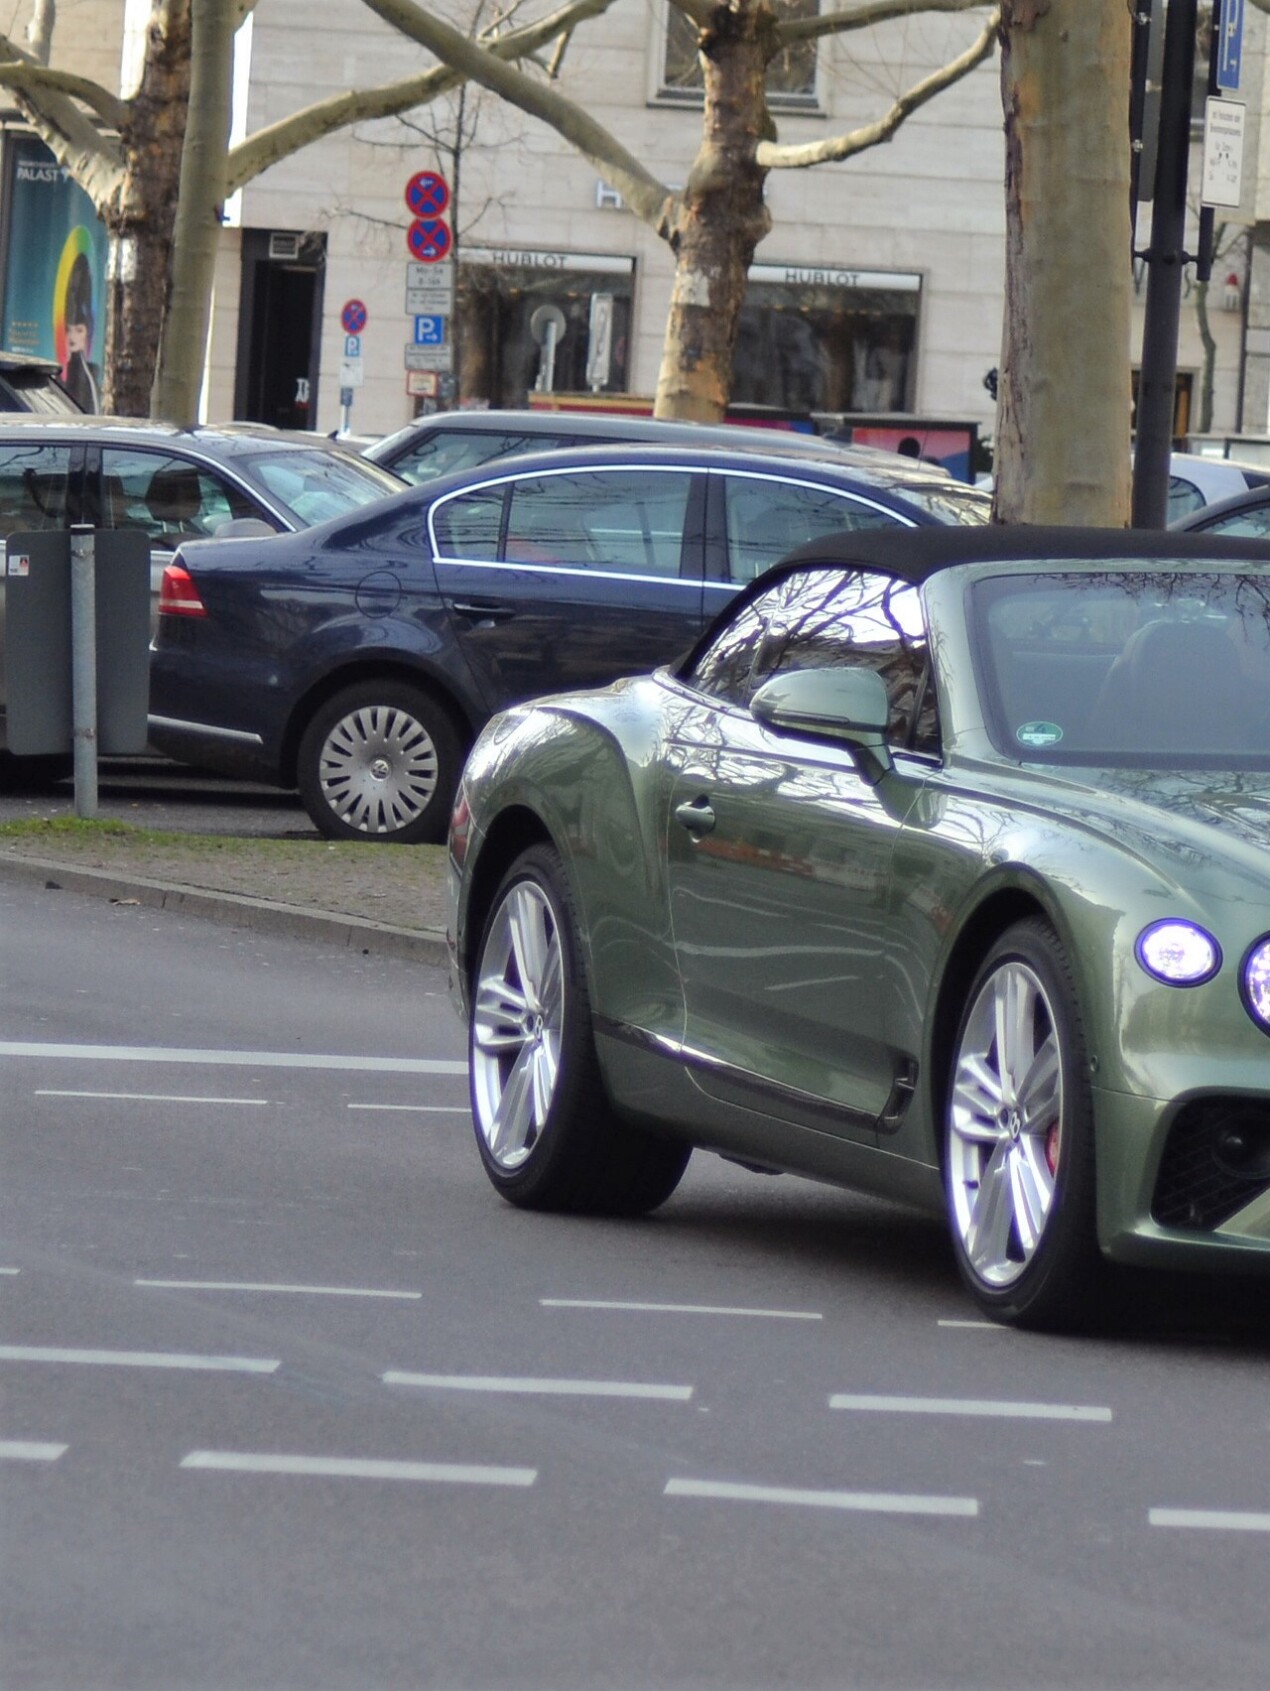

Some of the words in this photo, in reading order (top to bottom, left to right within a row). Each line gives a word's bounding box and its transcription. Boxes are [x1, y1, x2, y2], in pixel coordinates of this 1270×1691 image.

[17, 168, 59, 182] PALAST
[492, 251, 568, 269] HUBLOT
[785, 269, 860, 288] HUBLOT
[418, 318, 435, 341] P
